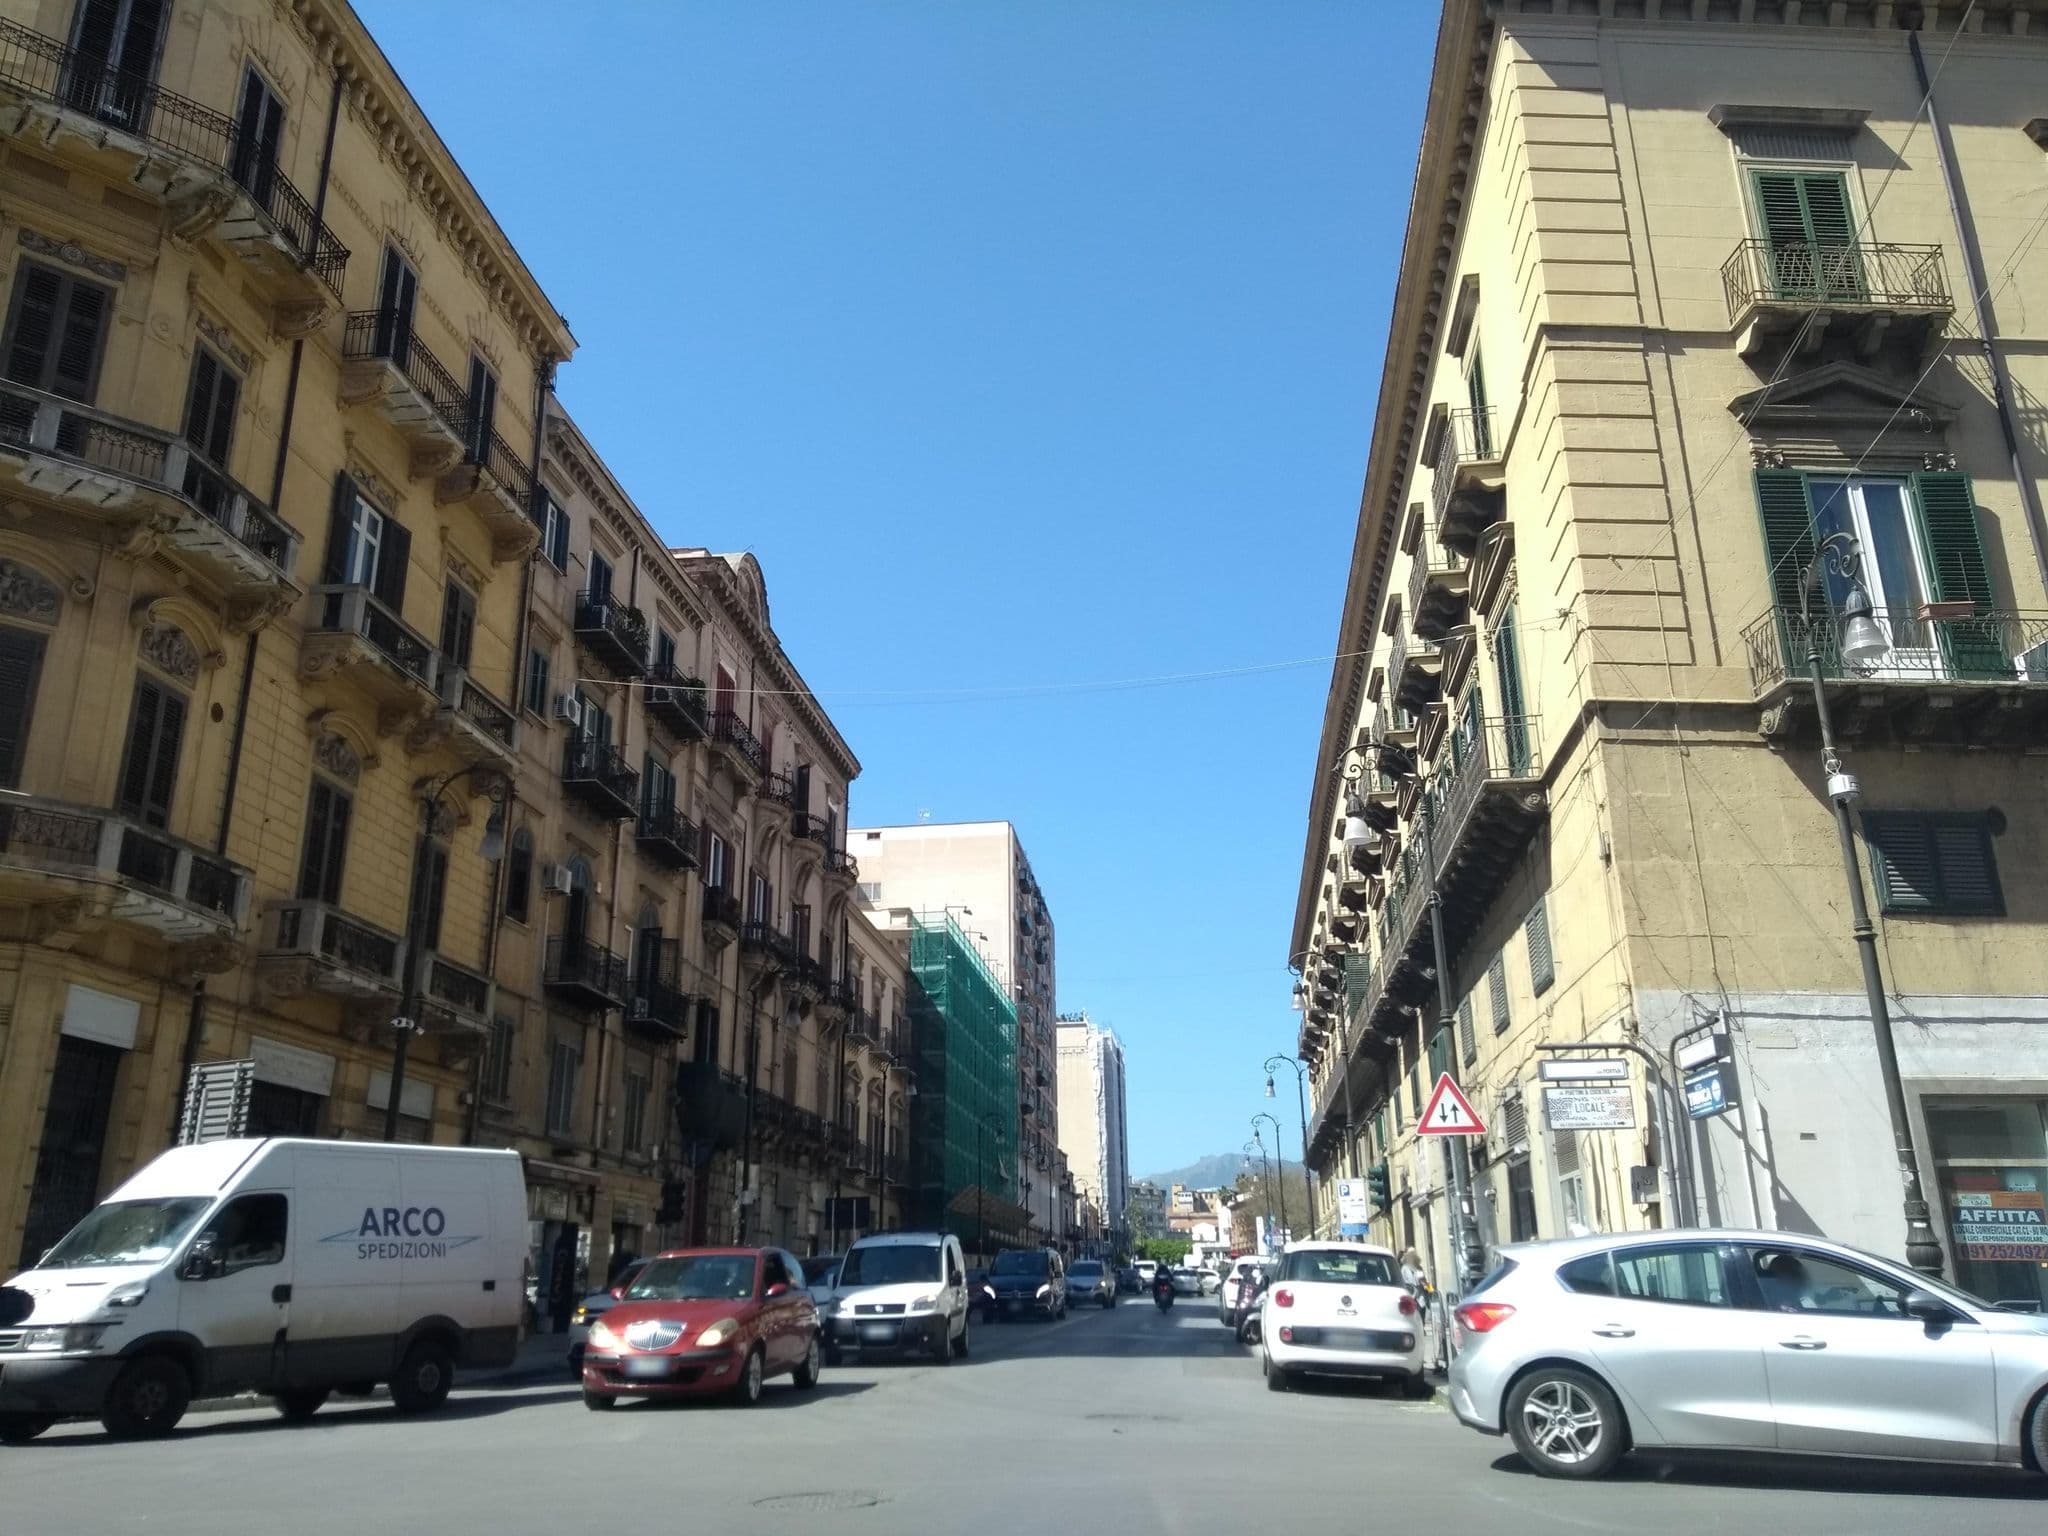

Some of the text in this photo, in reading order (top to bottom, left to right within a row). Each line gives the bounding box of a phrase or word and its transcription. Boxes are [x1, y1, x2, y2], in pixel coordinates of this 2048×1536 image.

[1574, 1102, 1606, 1113] LOCALE
[359, 1207, 446, 1237] ARCO
[1959, 1209, 2041, 1223] AFFITTA
[1954, 1224, 1974, 1234] LOCALE
[1975, 1225, 2013, 1235] COMMERCIALE
[358, 1242, 447, 1260] SPEDIZIONI
